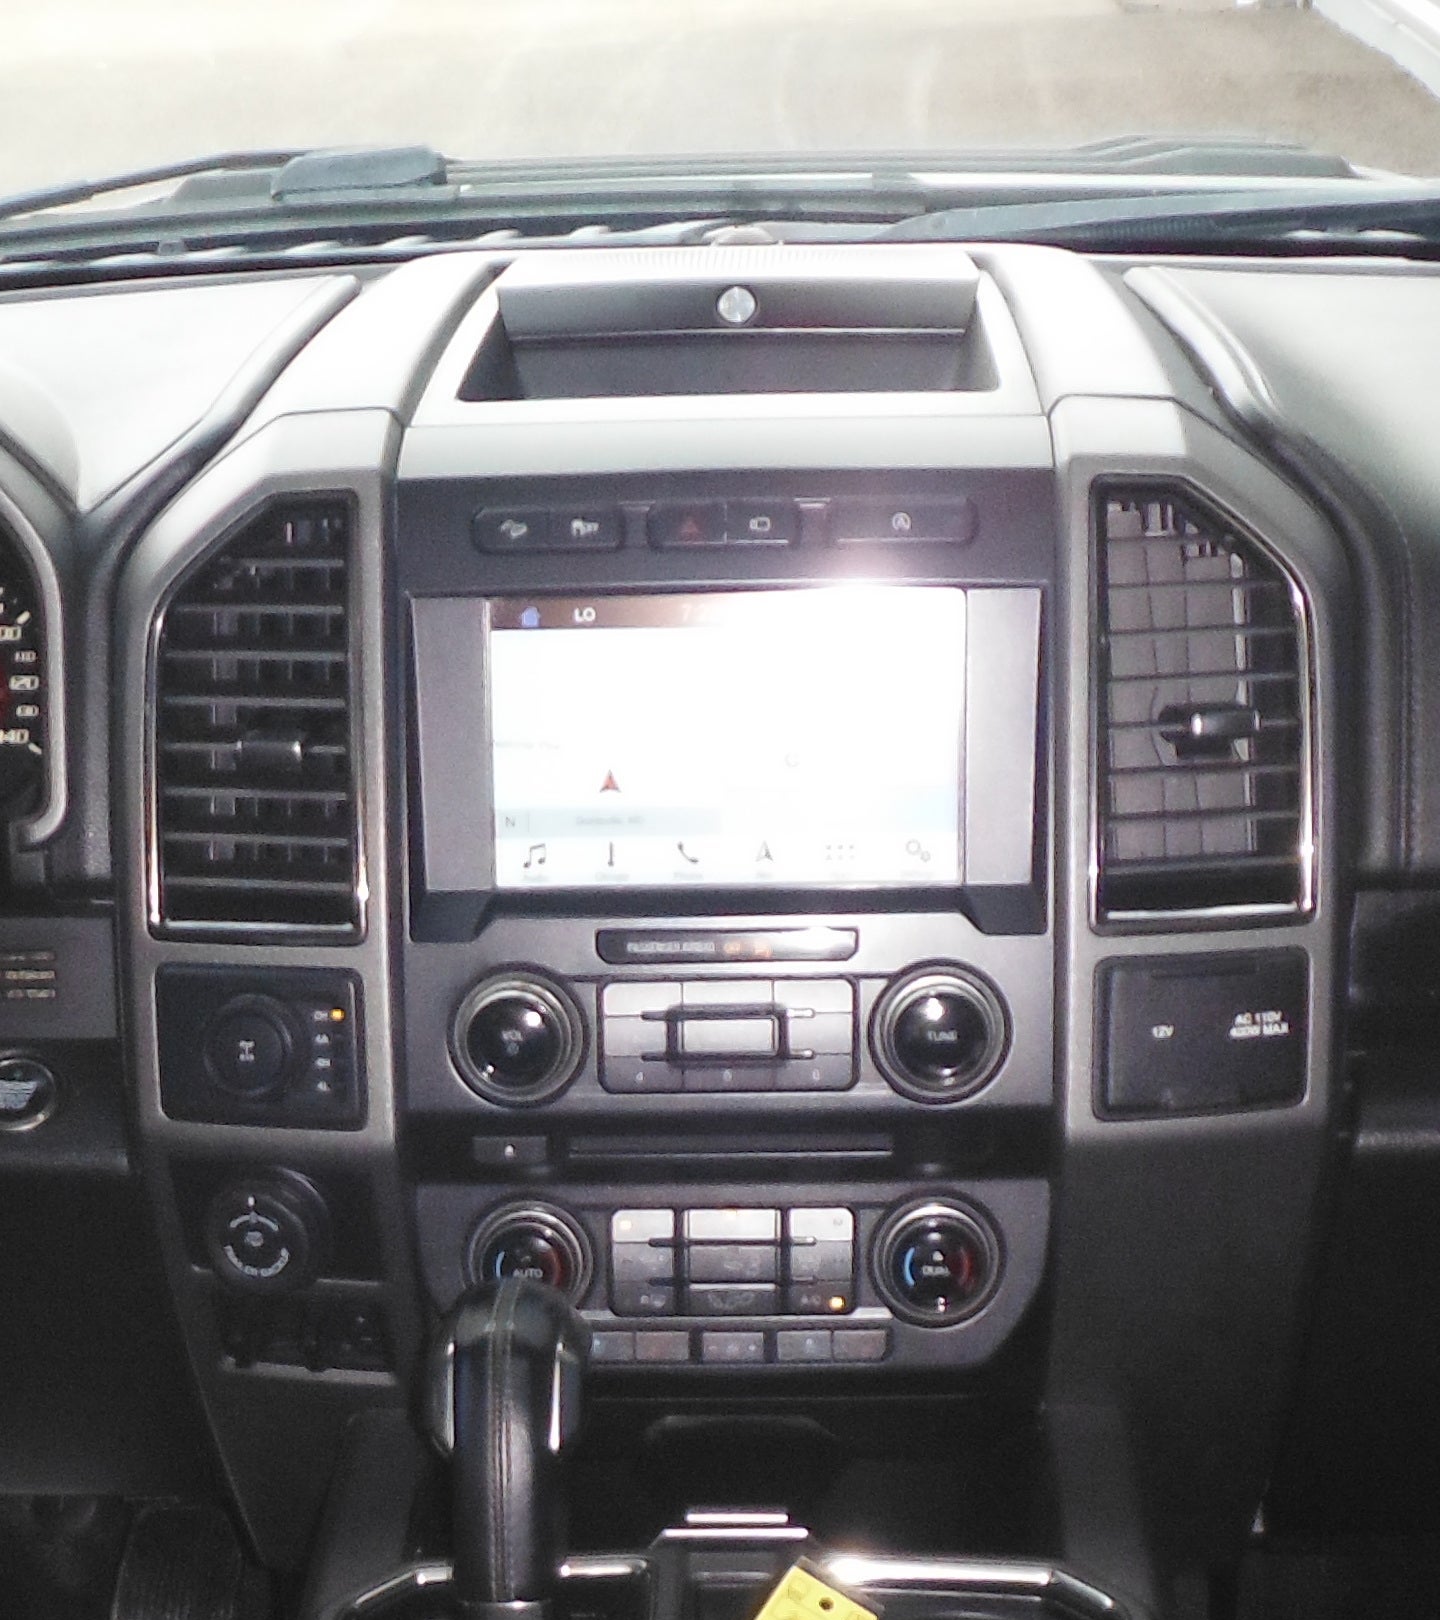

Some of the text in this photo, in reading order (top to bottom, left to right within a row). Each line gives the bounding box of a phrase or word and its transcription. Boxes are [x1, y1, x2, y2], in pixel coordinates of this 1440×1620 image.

[575, 607, 597, 622] LO
[10, 675, 39, 690] 120
[1152, 1024, 1175, 1038] 12V
[512, 1268, 544, 1280] AUTO
